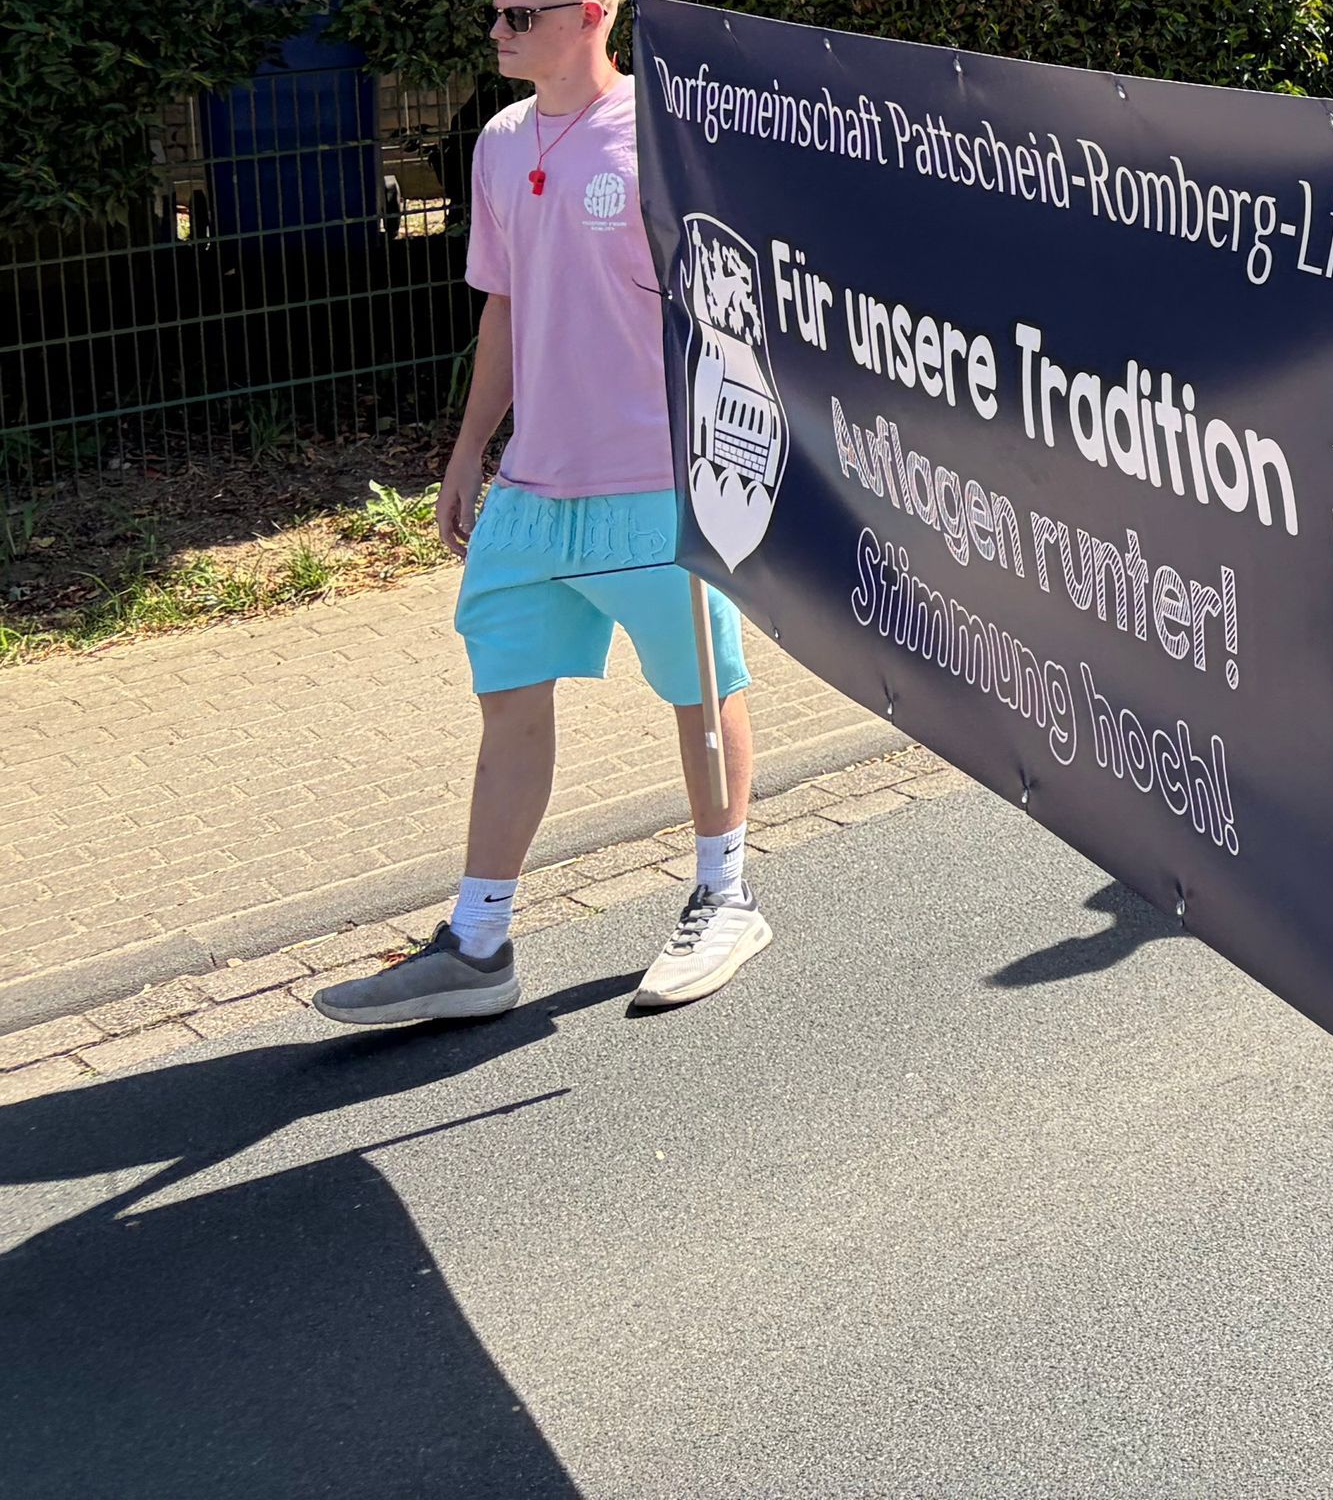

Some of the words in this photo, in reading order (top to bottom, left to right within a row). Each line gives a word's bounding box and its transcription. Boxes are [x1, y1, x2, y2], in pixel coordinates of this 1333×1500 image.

[583, 193, 627, 218] CHILL
[585, 173, 626, 197] JUST
[653, 55, 888, 166] Dorfgemeinschaft
[771, 239, 834, 352] Für
[845, 287, 998, 420] unsere
[1015, 321, 1299, 536] Tradition
[831, 396, 1024, 578] Auflagen
[1030, 511, 1239, 690] runter!
[851, 526, 1078, 766] Stimmung
[1080, 661, 1240, 856] hoch!
